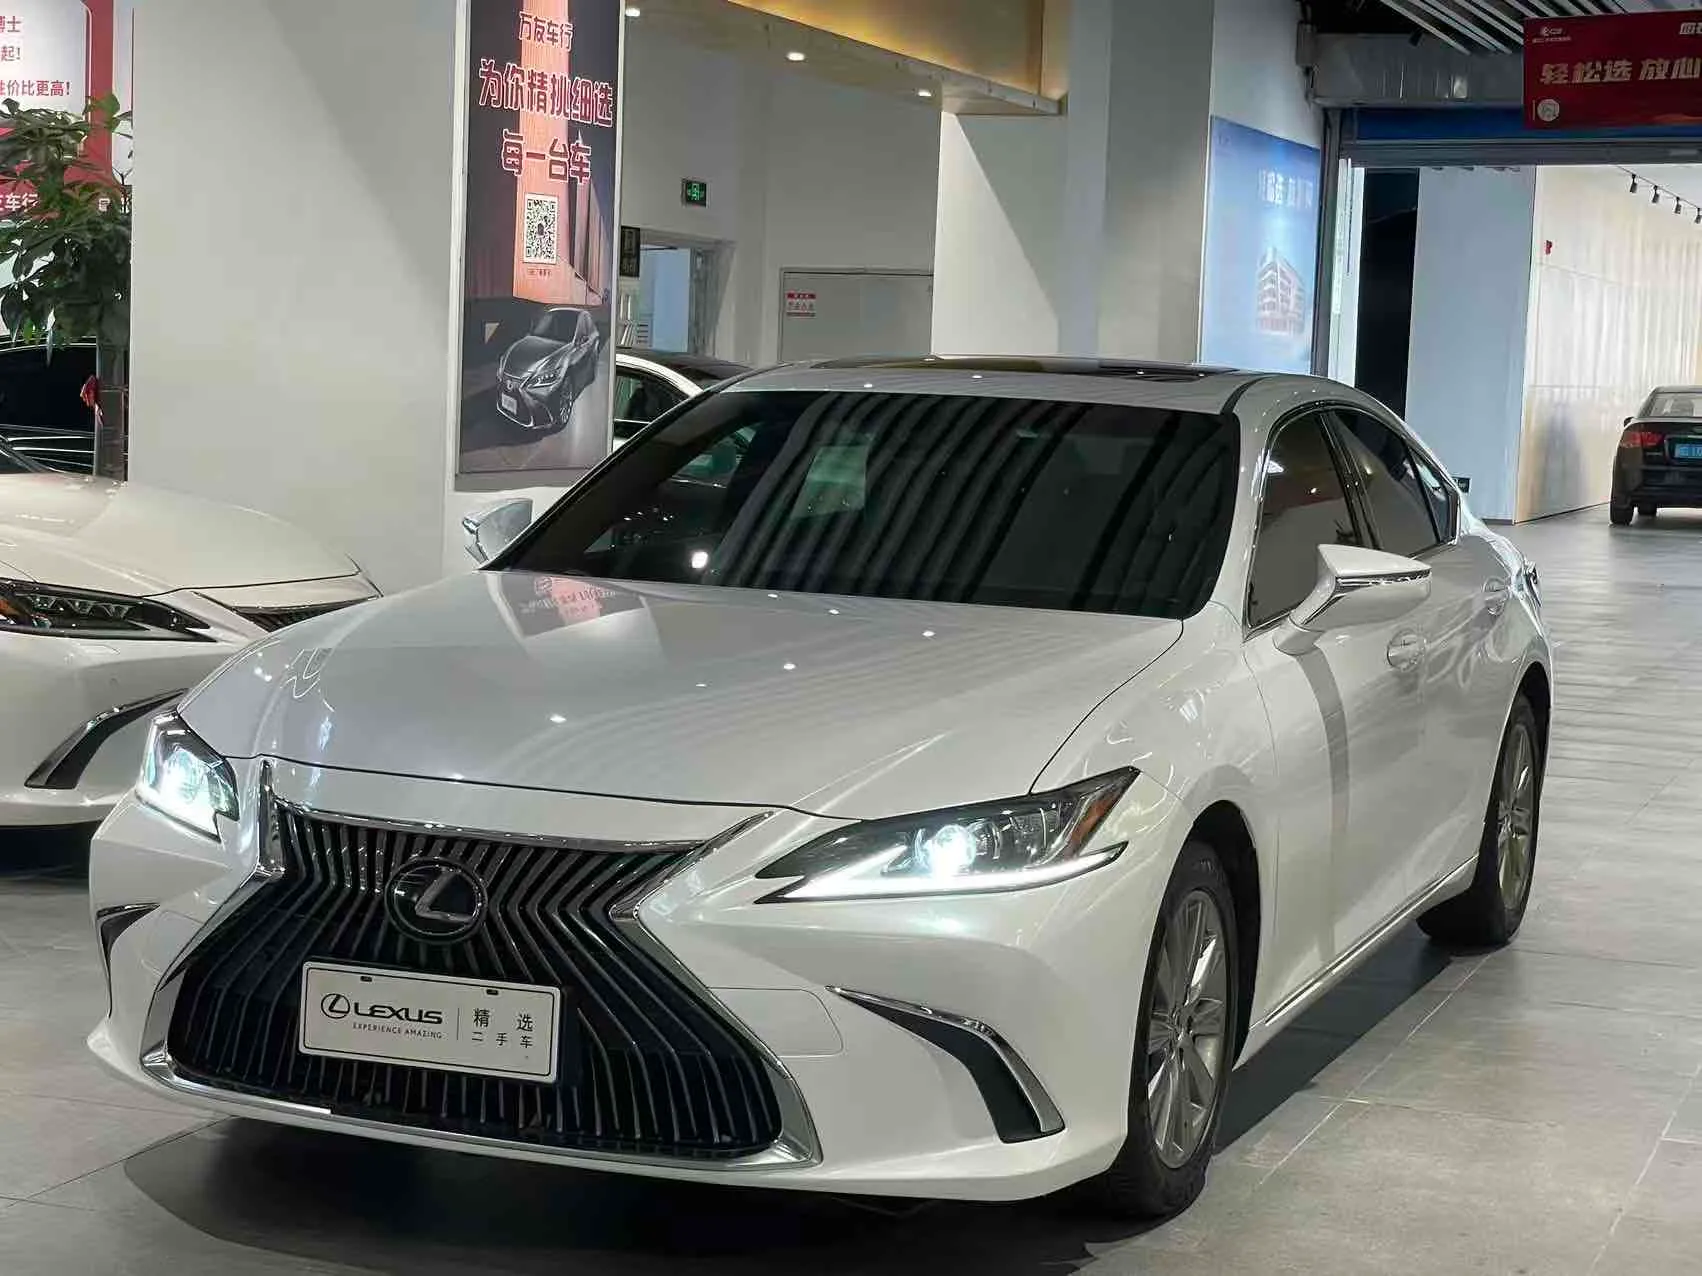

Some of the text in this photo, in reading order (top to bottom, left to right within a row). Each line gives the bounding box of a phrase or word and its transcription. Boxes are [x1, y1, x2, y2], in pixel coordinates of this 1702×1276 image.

[518, 11, 574, 52] 万友车行
[1540, 55, 1702, 85] 轻松选 放心
[478, 58, 613, 127] 为你精挑细选
[502, 128, 591, 185] 每一台车
[0, 192, 38, 213] 车行
[354, 1002, 443, 1025] LEXUS
[353, 1021, 442, 1040] EXPERIENCE AMAZING
